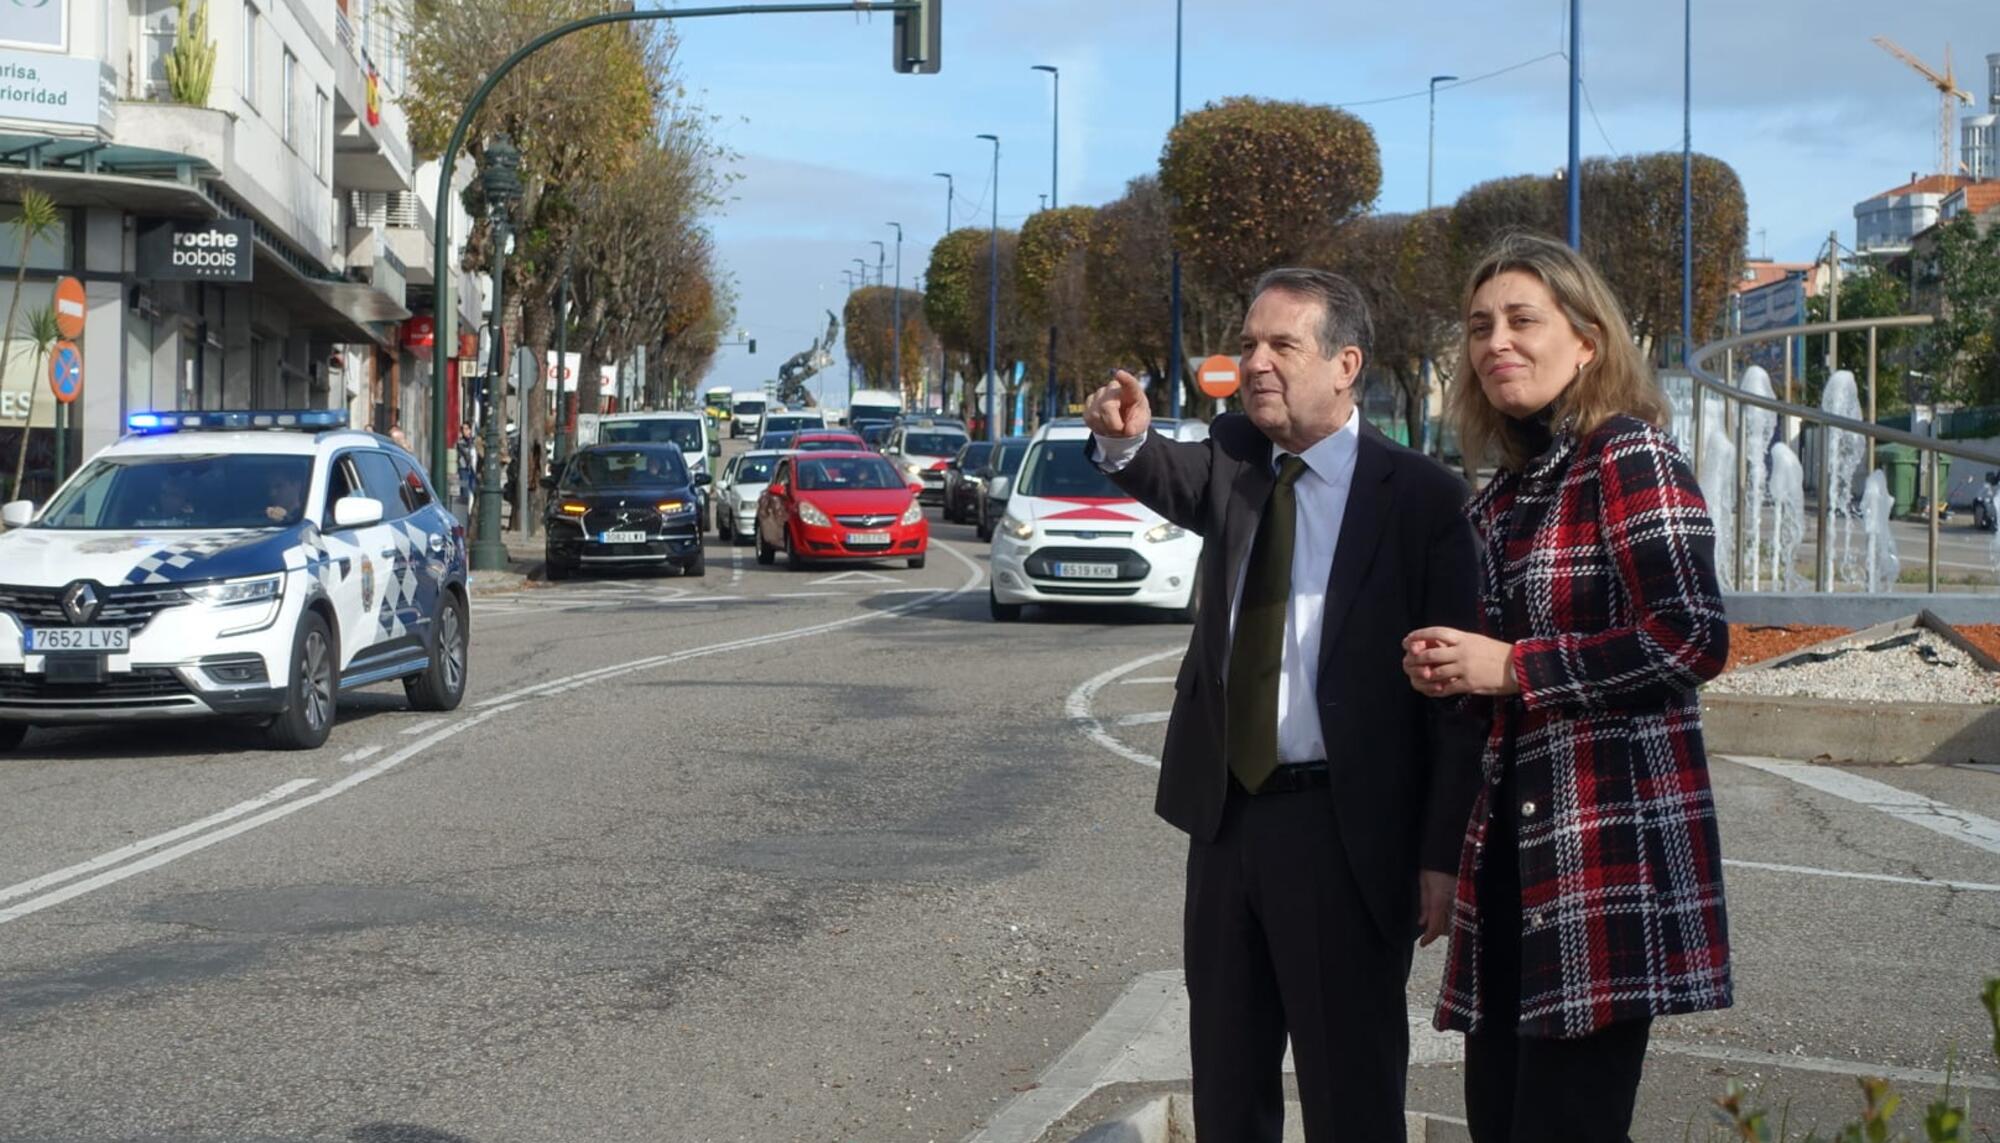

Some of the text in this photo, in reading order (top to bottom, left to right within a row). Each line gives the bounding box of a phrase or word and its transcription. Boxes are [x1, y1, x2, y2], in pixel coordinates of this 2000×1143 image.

[0, 62, 40, 82] risa,
[173, 229, 239, 248] roche
[172, 248, 237, 267] bobois
[1, 391, 31, 417] ES
[36, 630, 124, 648] 7652 LVS
